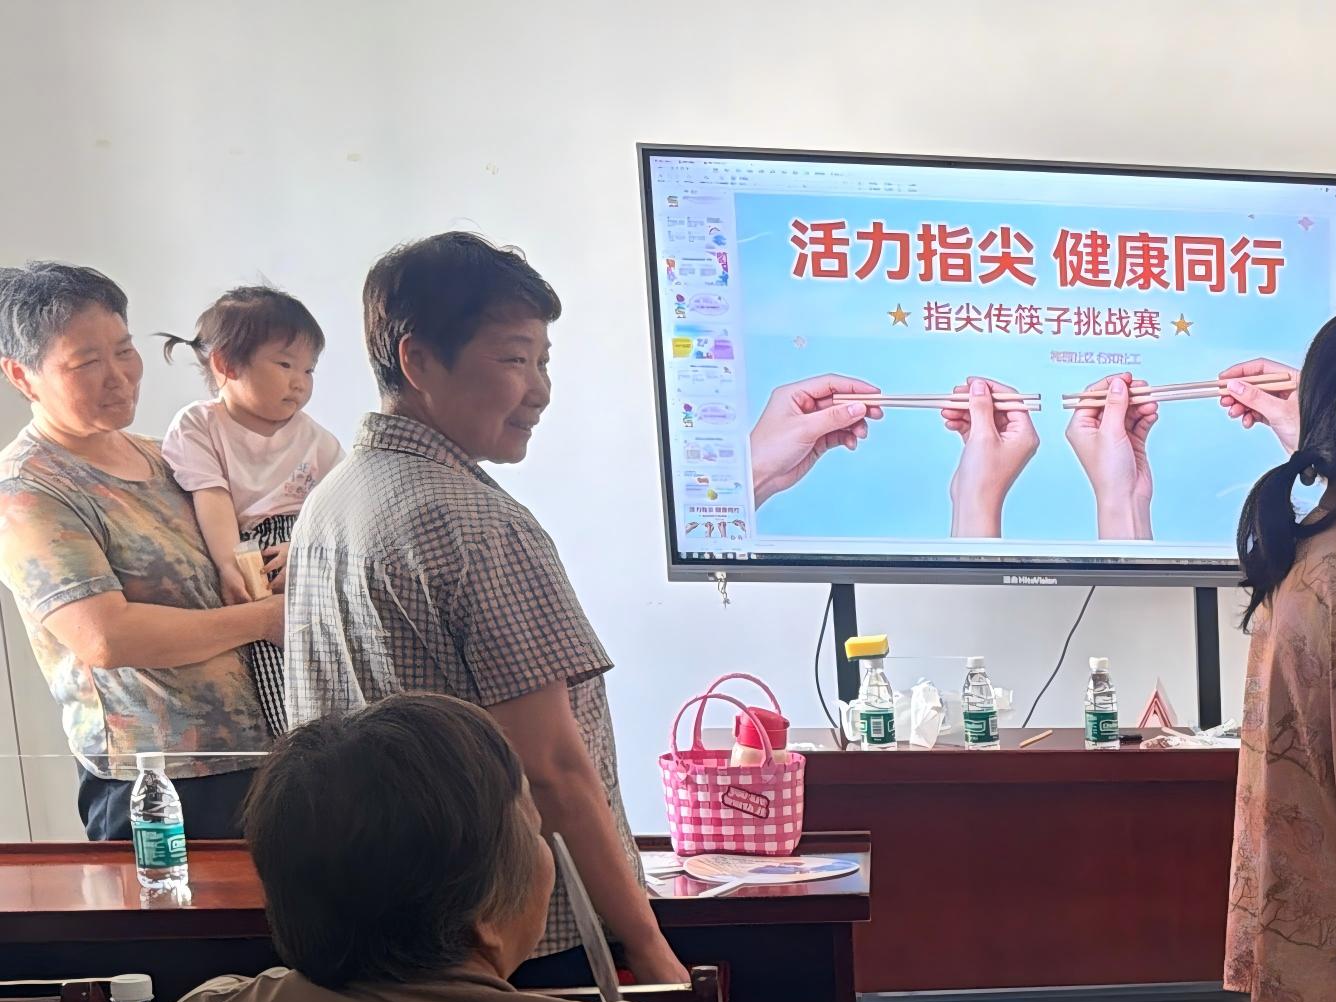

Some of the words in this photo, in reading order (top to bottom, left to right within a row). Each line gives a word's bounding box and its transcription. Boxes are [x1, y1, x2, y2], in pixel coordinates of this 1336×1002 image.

[791, 220, 1036, 285] 活力指尖
[1053, 229, 1284, 294] 健康同行
[923, 301, 1161, 339] 指尖传筷子挑战赛
